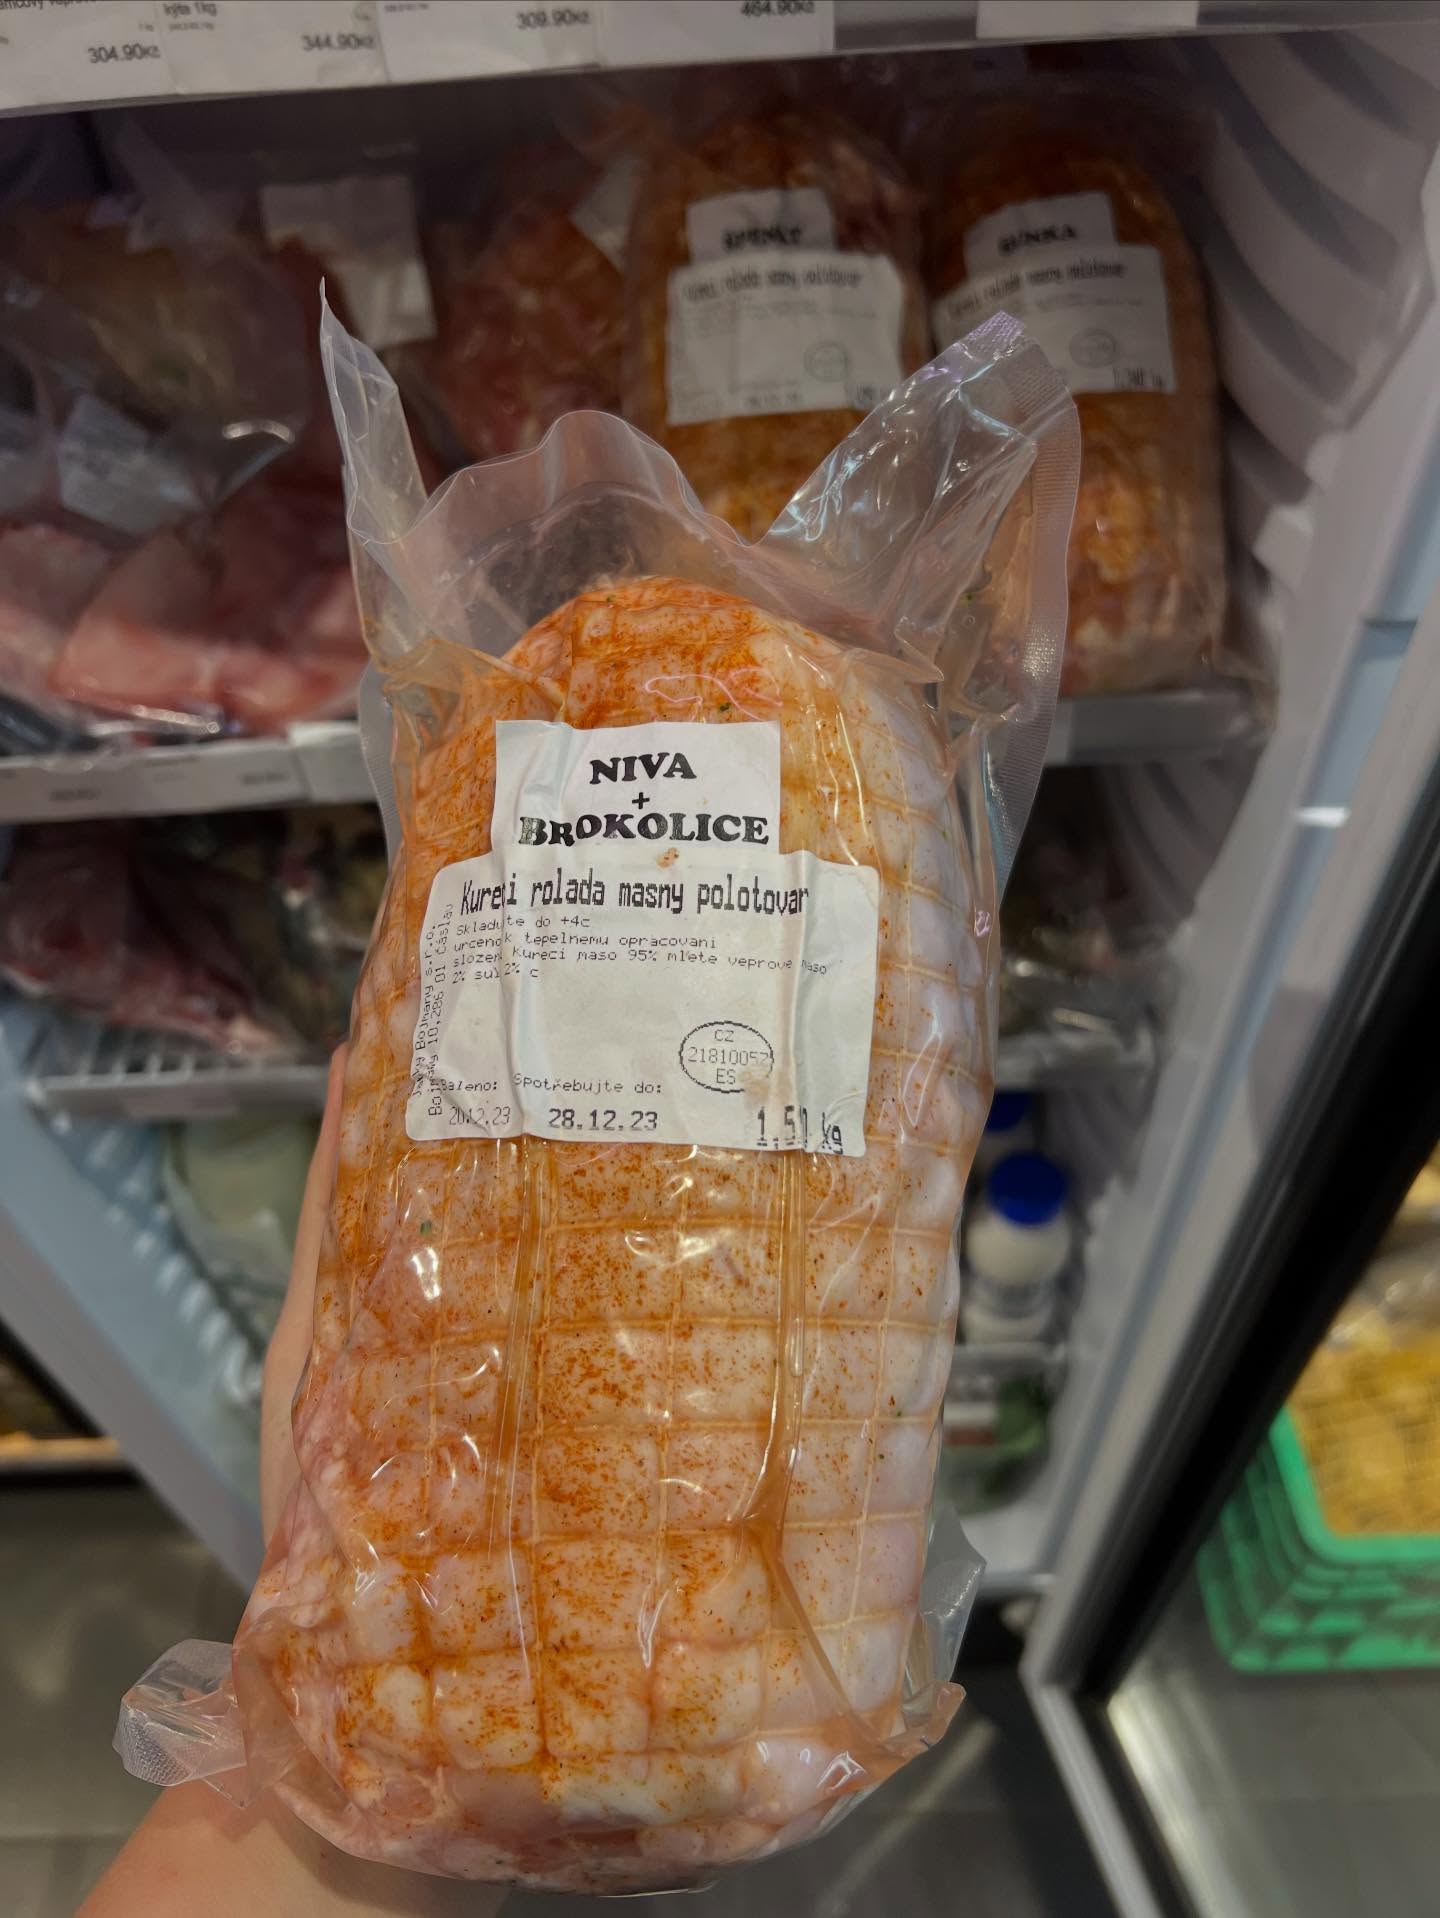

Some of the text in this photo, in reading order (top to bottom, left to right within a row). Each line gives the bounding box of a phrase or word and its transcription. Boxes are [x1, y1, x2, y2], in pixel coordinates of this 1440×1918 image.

[589, 752, 697, 784] NIVA
[631, 792, 650, 809] +
[518, 812, 770, 847] BROKOLICE
[530, 867, 605, 907] rolada
[618, 882, 684, 915] masny
[696, 873, 809, 917] polotovar
[535, 915, 551, 928] do
[525, 932, 609, 947] tepelnemu
[618, 936, 717, 948] opracovani
[576, 950, 618, 962] maso
[628, 949, 657, 962] 95%
[667, 950, 718, 965] mlete
[727, 955, 793, 972] veprove
[714, 1029, 735, 1043] CZ
[716, 1068, 736, 1085] ES
[634, 1077, 662, 1094] do:
[548, 1108, 658, 1132] 28.12.23
